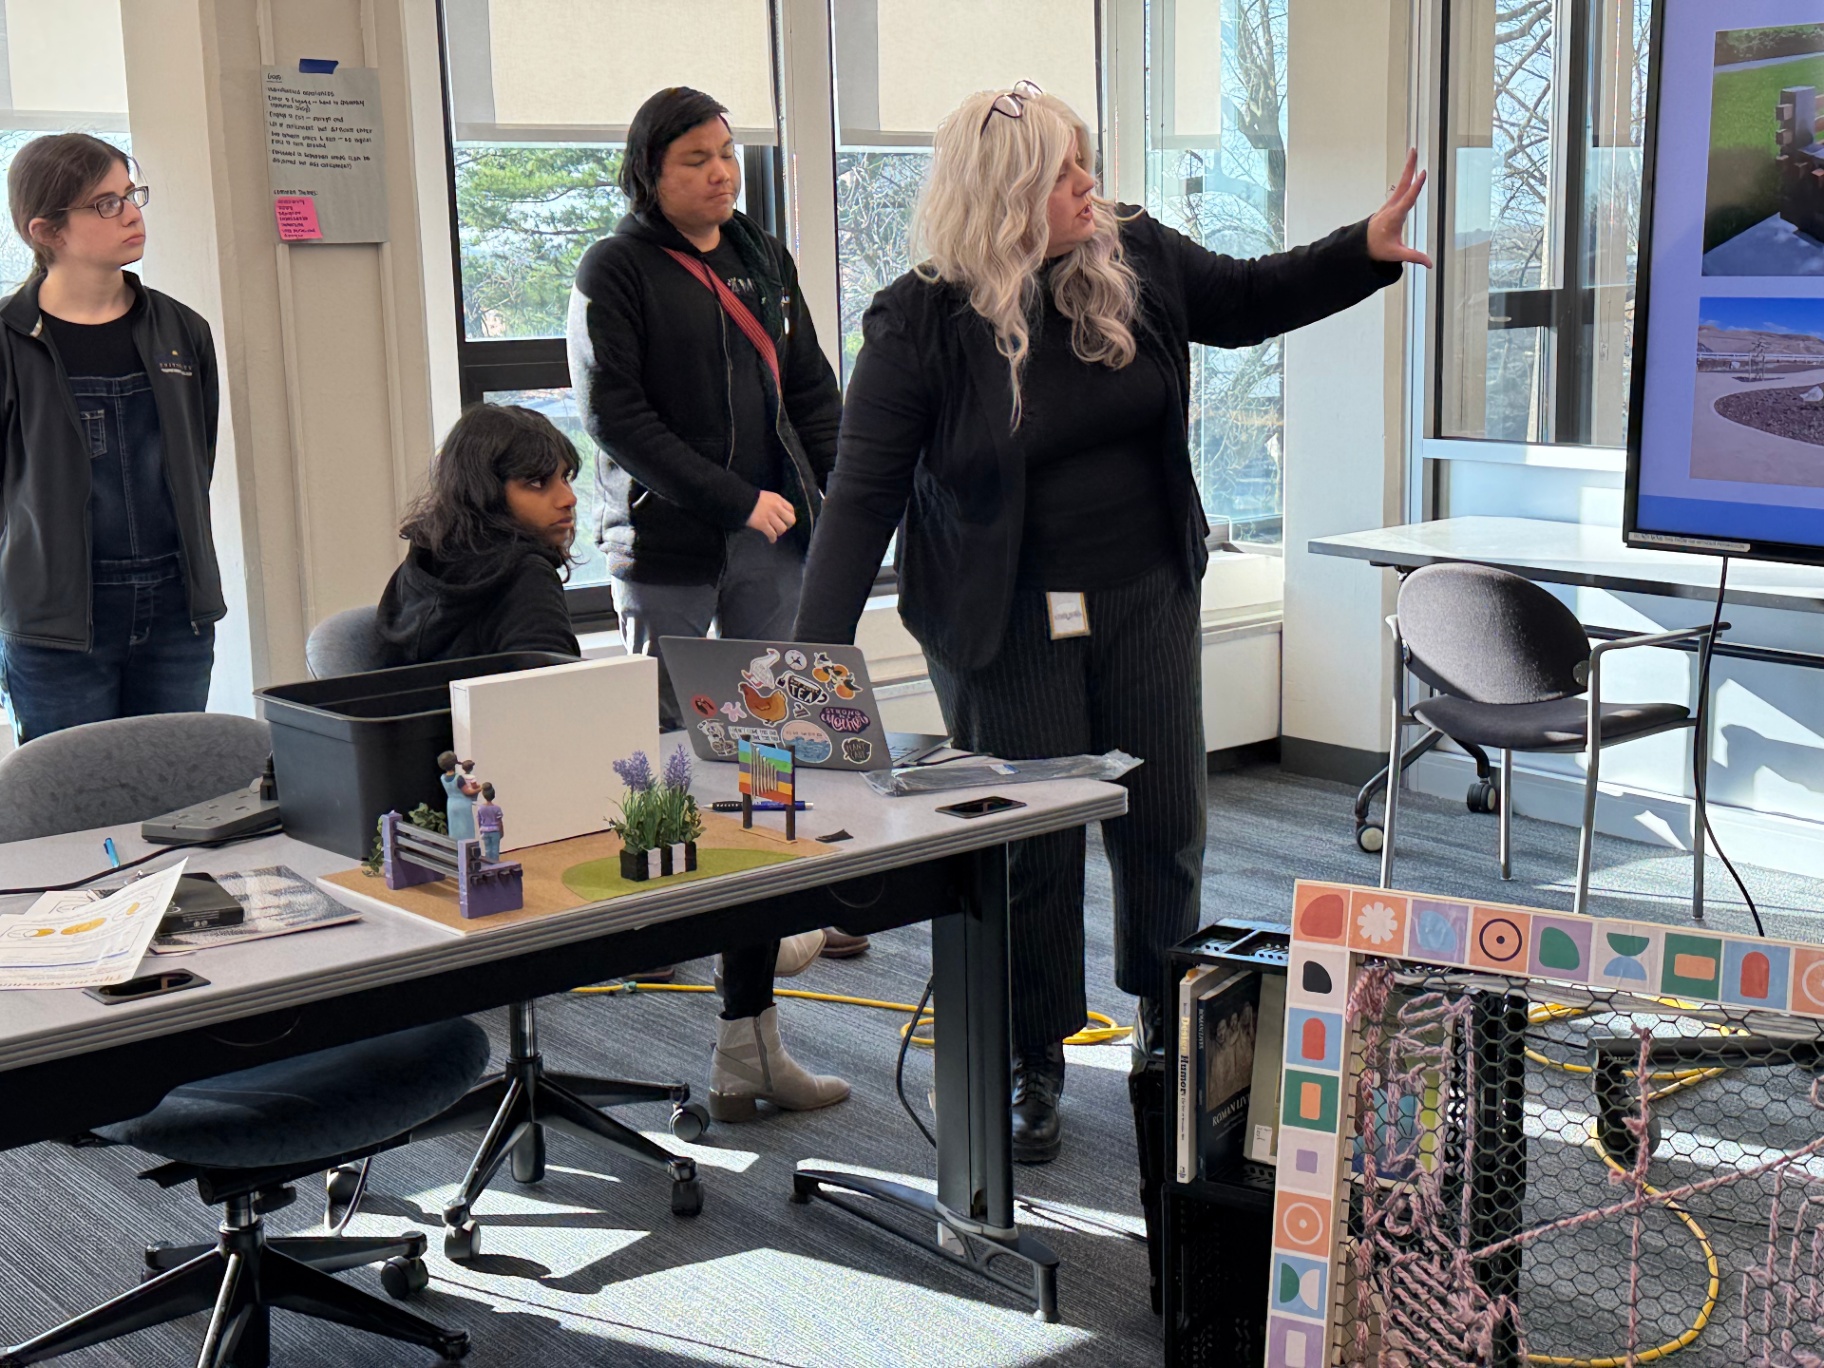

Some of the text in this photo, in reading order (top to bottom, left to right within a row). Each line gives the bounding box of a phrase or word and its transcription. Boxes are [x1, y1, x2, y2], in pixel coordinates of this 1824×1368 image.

[790, 683, 813, 703] TEA
[1180, 1016, 1190, 1056] Design
[1212, 1101, 1236, 1127] ROMAN
